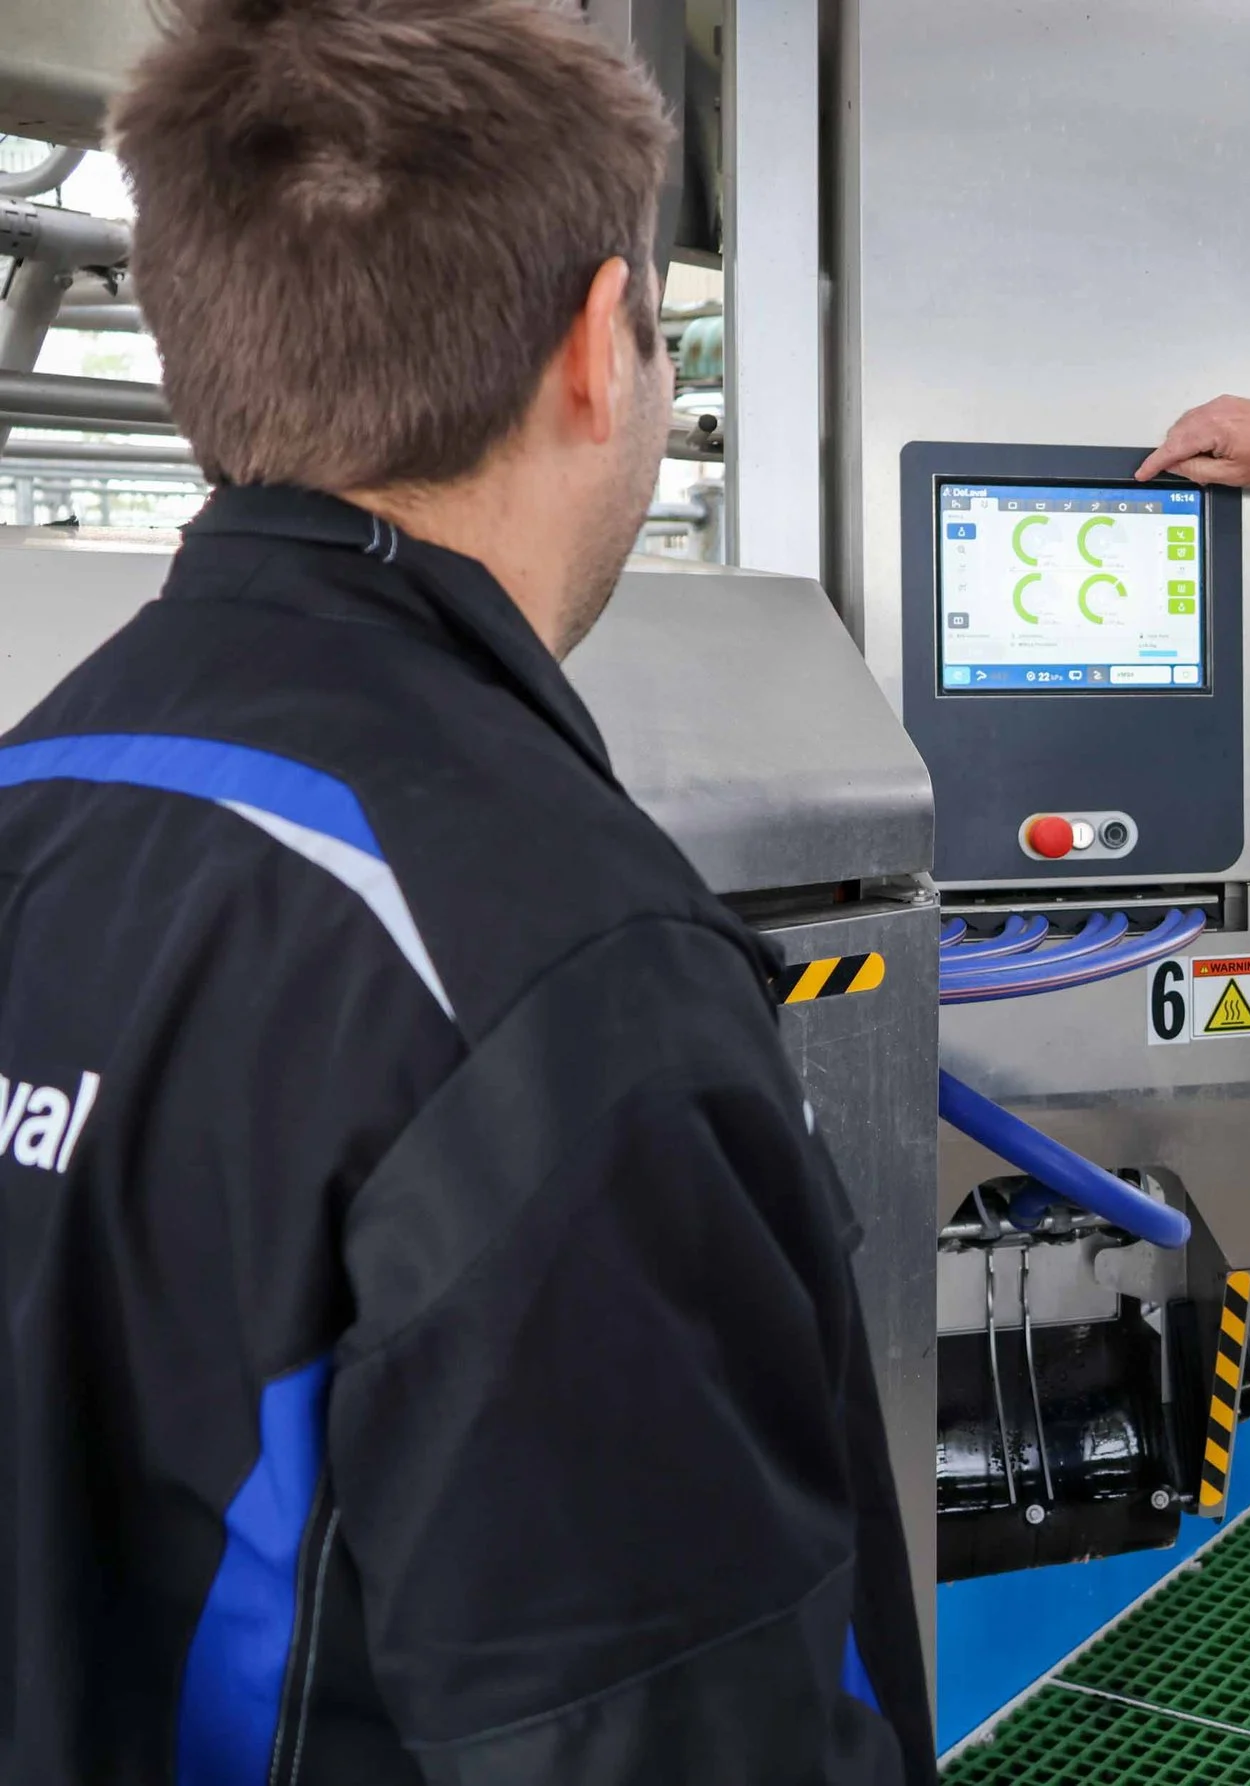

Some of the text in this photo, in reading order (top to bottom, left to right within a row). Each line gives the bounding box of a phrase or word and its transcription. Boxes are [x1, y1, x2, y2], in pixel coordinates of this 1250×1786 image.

[1170, 493, 1195, 502] 15:14
[1038, 672, 1050, 682] 22
[1151, 960, 1186, 1040] 6
